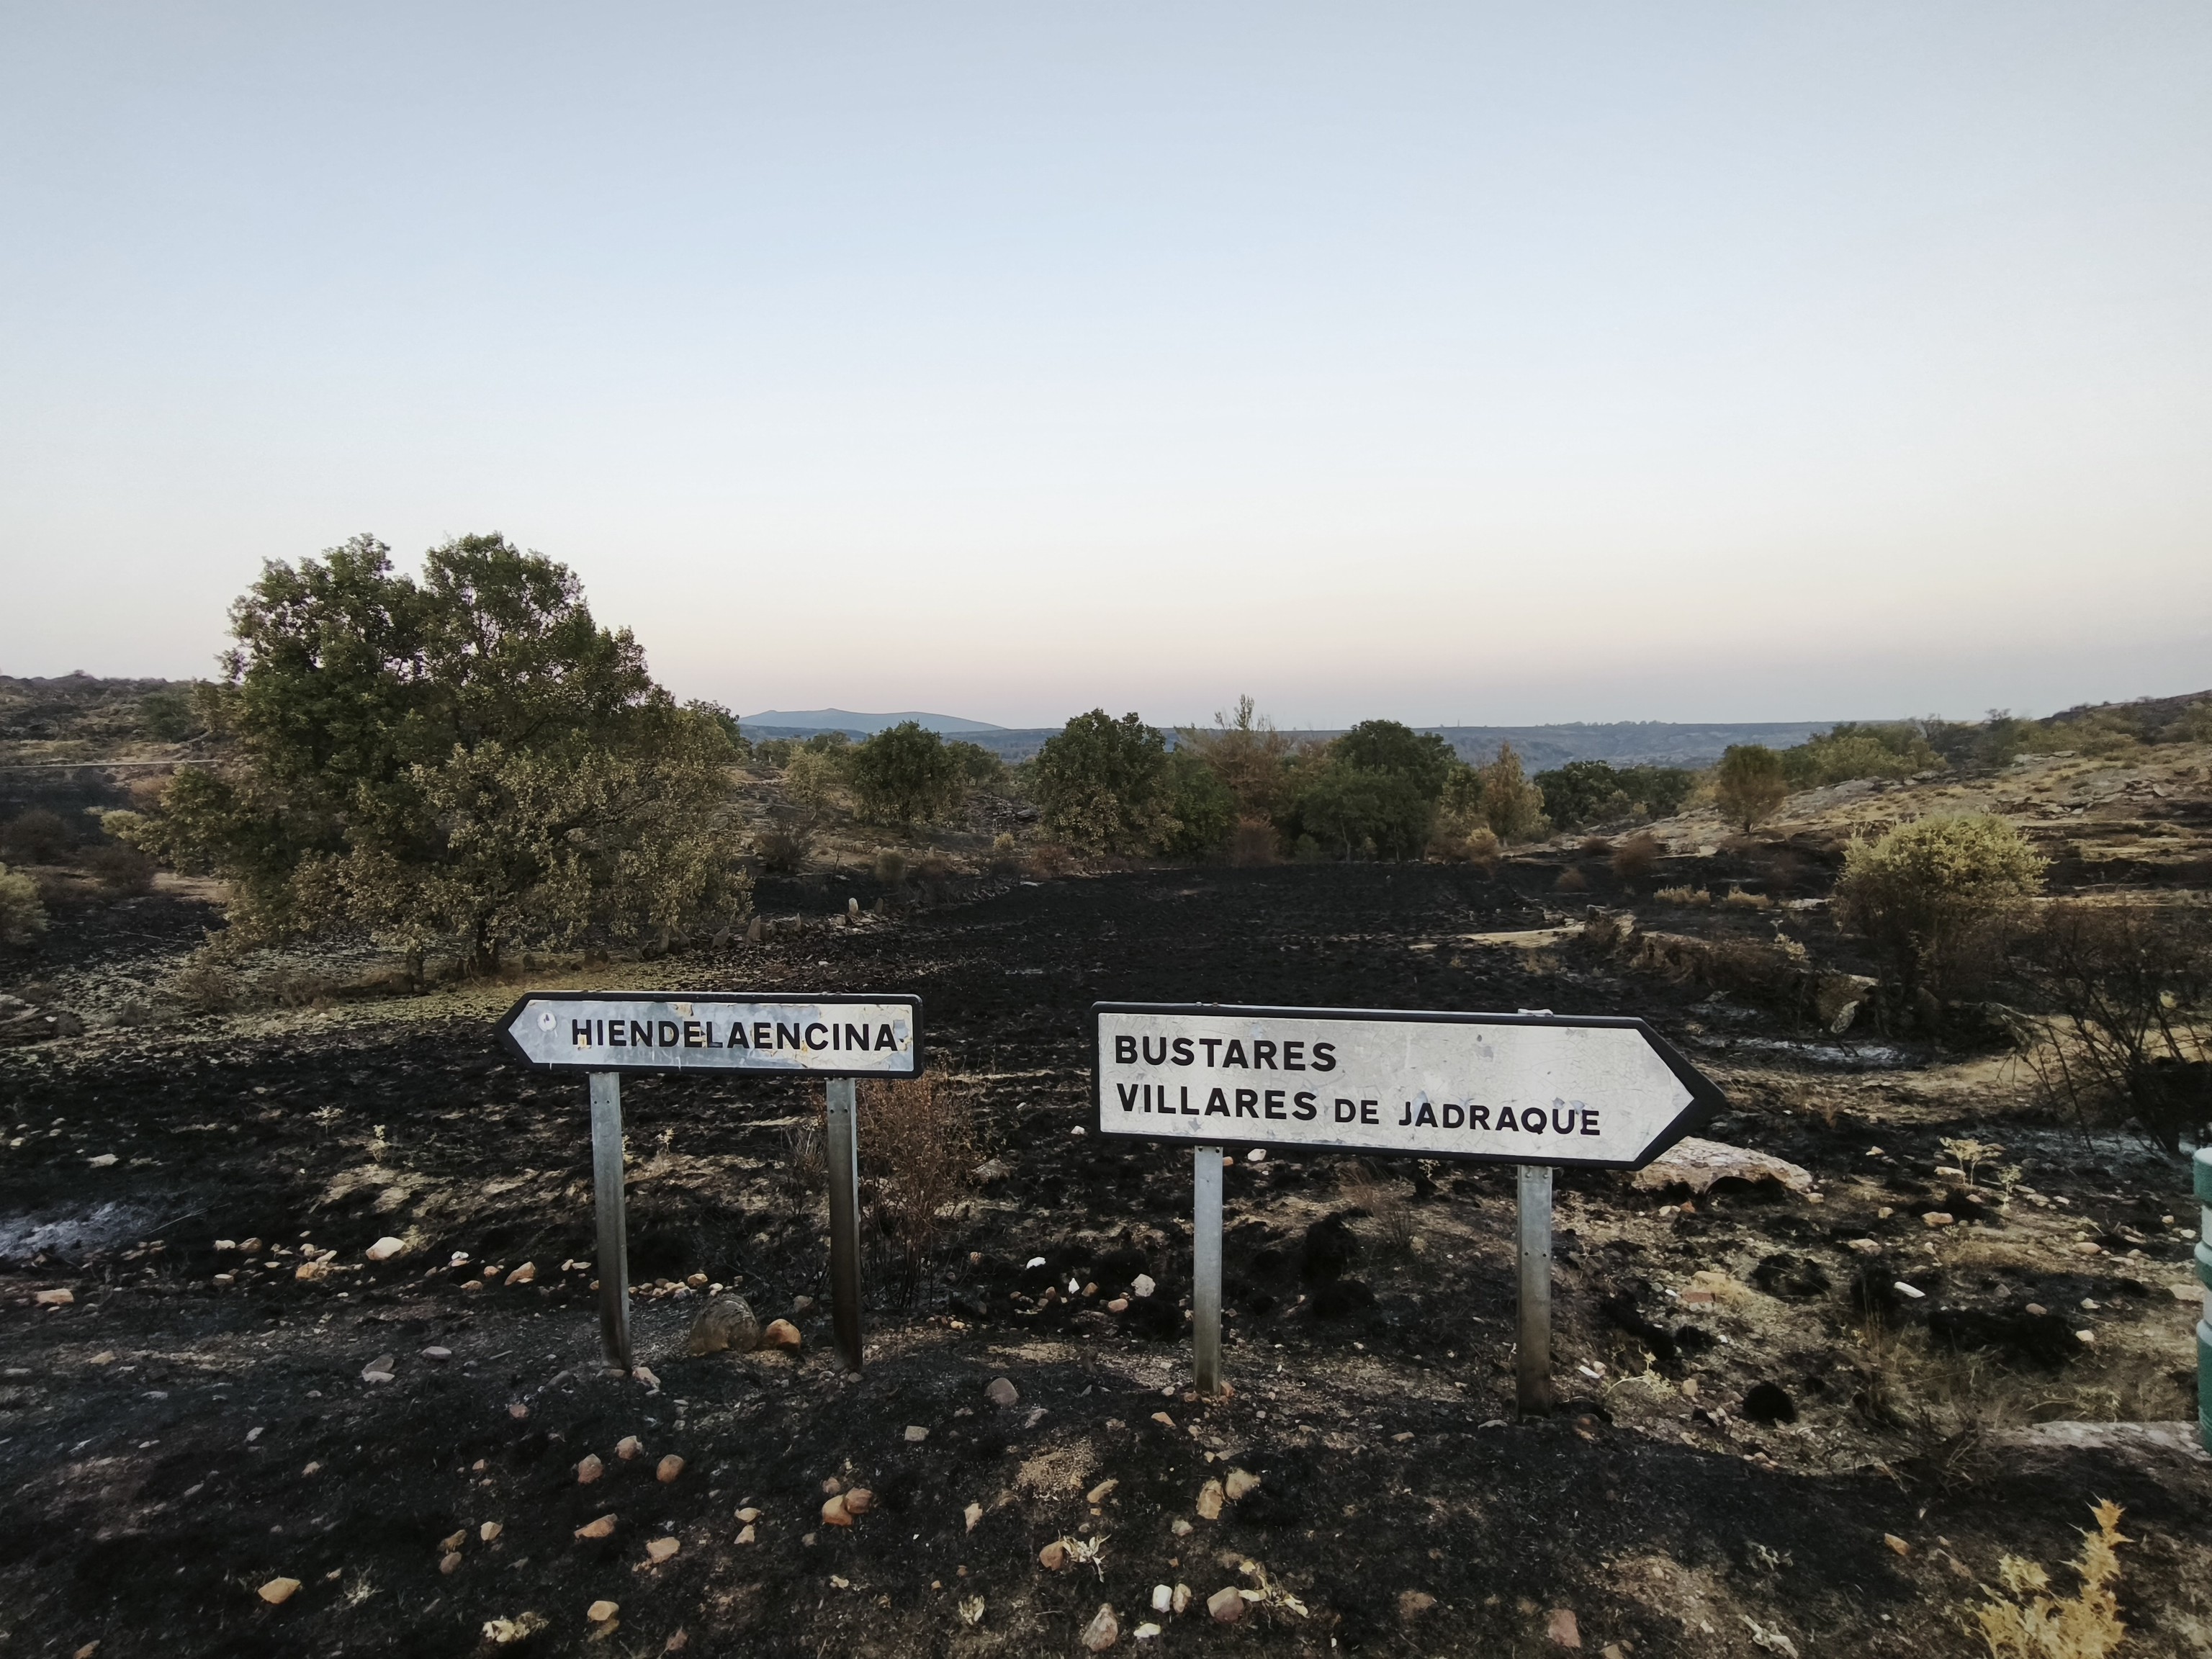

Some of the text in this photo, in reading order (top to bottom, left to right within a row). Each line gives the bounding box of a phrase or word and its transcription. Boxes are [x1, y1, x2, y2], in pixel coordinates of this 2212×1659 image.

[572, 1019, 899, 1051] HIENDELAENCINA
[1115, 1035, 1336, 1071] BUSTARES
[1116, 1083, 1601, 1136] VILLARES DE JADRAQUE
